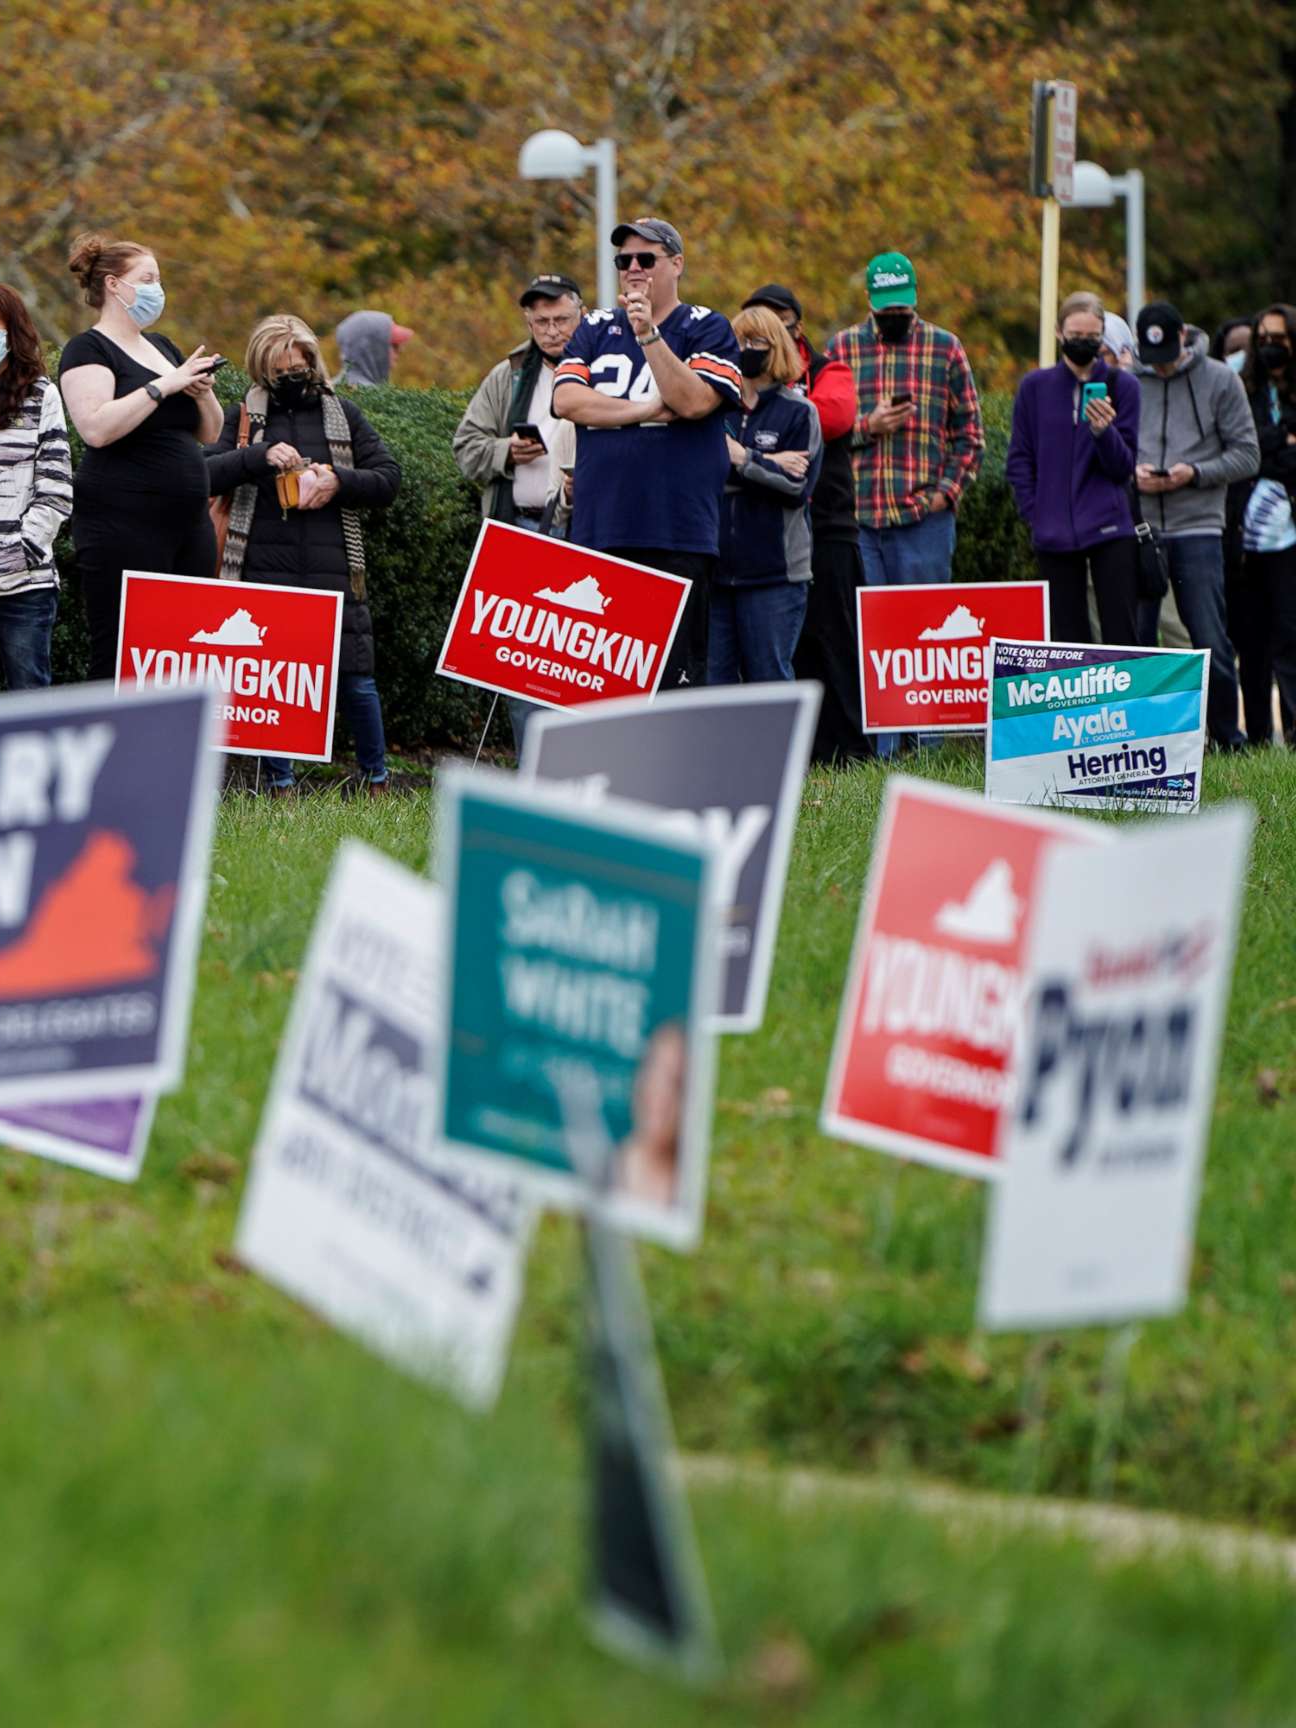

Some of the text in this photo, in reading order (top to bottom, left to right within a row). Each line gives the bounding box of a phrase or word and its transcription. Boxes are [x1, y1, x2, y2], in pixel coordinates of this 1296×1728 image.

[470, 589, 658, 689] YOUNGKIN
[997, 646, 1084, 660] VOTE ON OR BEFORE
[130, 647, 325, 713] YOUNGKIN
[495, 646, 605, 692] GOVERNOR
[869, 646, 990, 690] YOUNG
[996, 656, 1016, 666] NOV.
[1025, 659, 1046, 668] 2021
[905, 688, 988, 705] GOVERNO
[1007, 665, 1132, 707] McAuliffe
[1047, 697, 1096, 709] GOVERNOR
[1053, 706, 1128, 746] Ayala
[1093, 730, 1136, 742] GOVERNOR
[1068, 743, 1167, 779] Herring
[1078, 770, 1150, 785] ATTORNEY GENERAL
[503, 955, 652, 1060] WHITE
